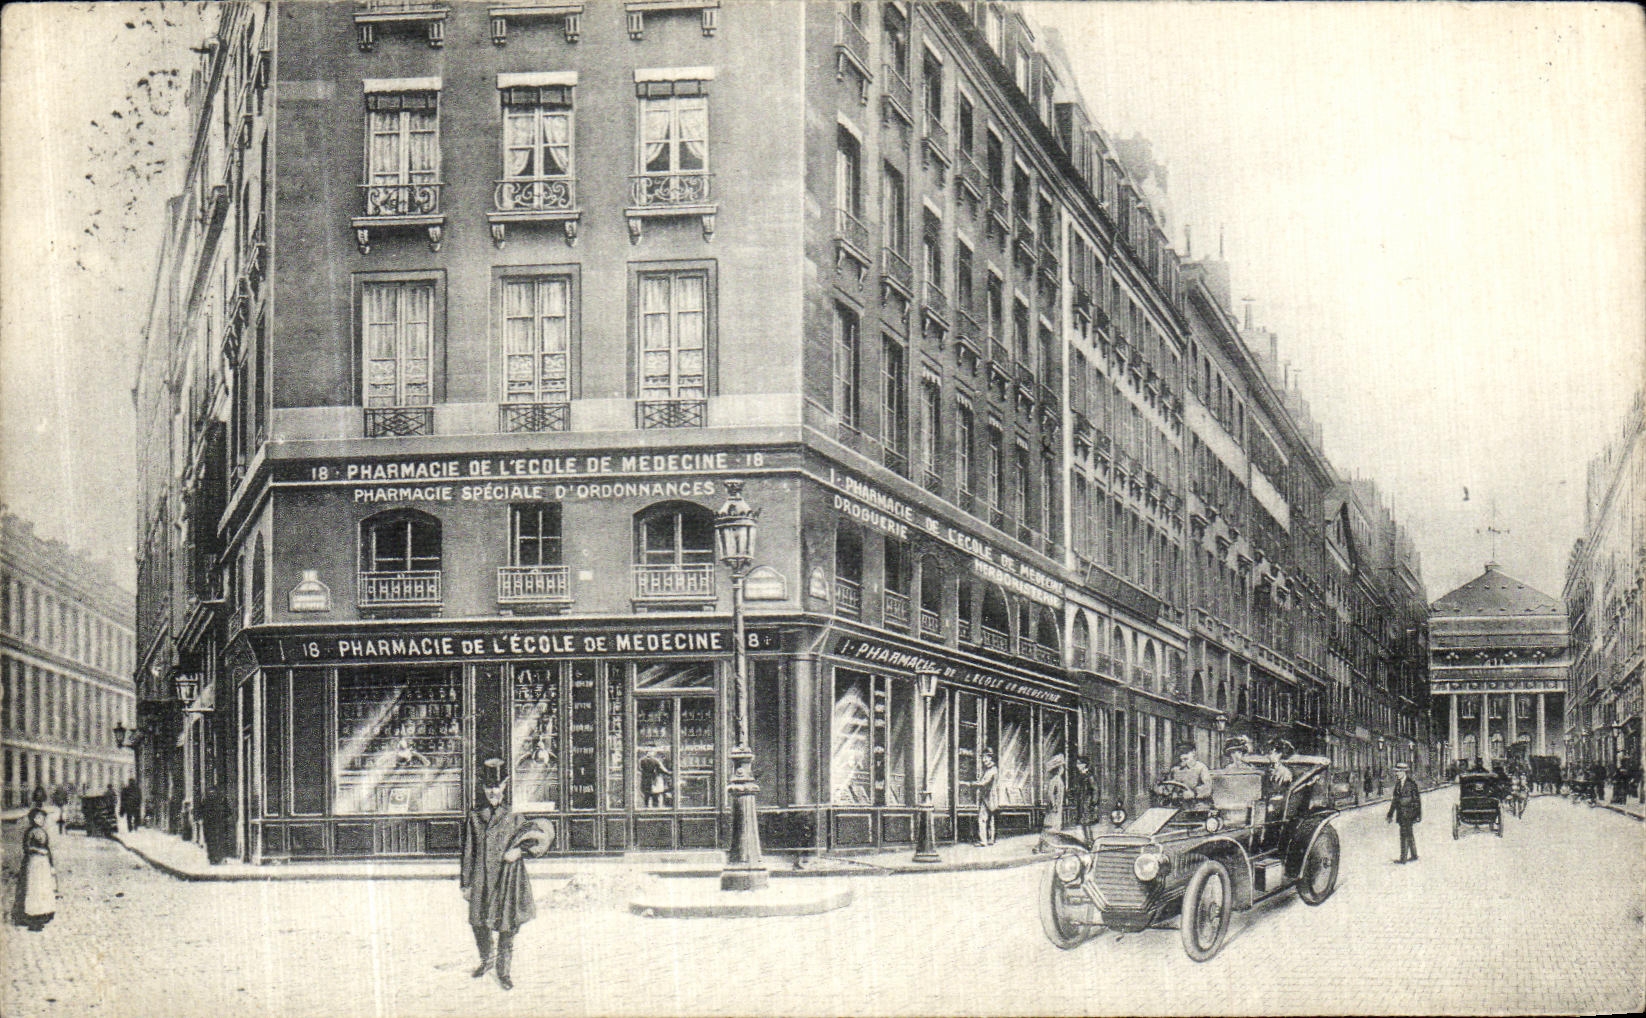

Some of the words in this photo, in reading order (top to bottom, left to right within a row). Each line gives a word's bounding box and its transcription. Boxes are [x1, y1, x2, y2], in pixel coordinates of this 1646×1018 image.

[311, 467, 328, 480] 18
[347, 462, 459, 479] PHARMACIE
[469, 461, 491, 476] DE
[500, 457, 577, 474] L'ECOLE
[587, 456, 612, 472] DE
[622, 453, 728, 472] MEDECINE
[746, 453, 764, 467] 18
[354, 488, 452, 501] PHARMACIE
[462, 482, 542, 500] SPÉCIALE
[555, 481, 715, 499] D'ORDONNANCES
[834, 494, 908, 540] DROGUERIE
[845, 476, 913, 521] PHARMACIE
[925, 517, 939, 534] DE
[1001, 554, 1015, 571] DE
[303, 643, 320, 658] 18
[338, 639, 453, 657] PHARMACIE
[462, 639, 485, 653] DE
[493, 634, 575, 653] L'ÉCOLE
[584, 636, 606, 651] DE
[616, 632, 722, 652] MEDECINE
[944, 667, 956, 677] DE
